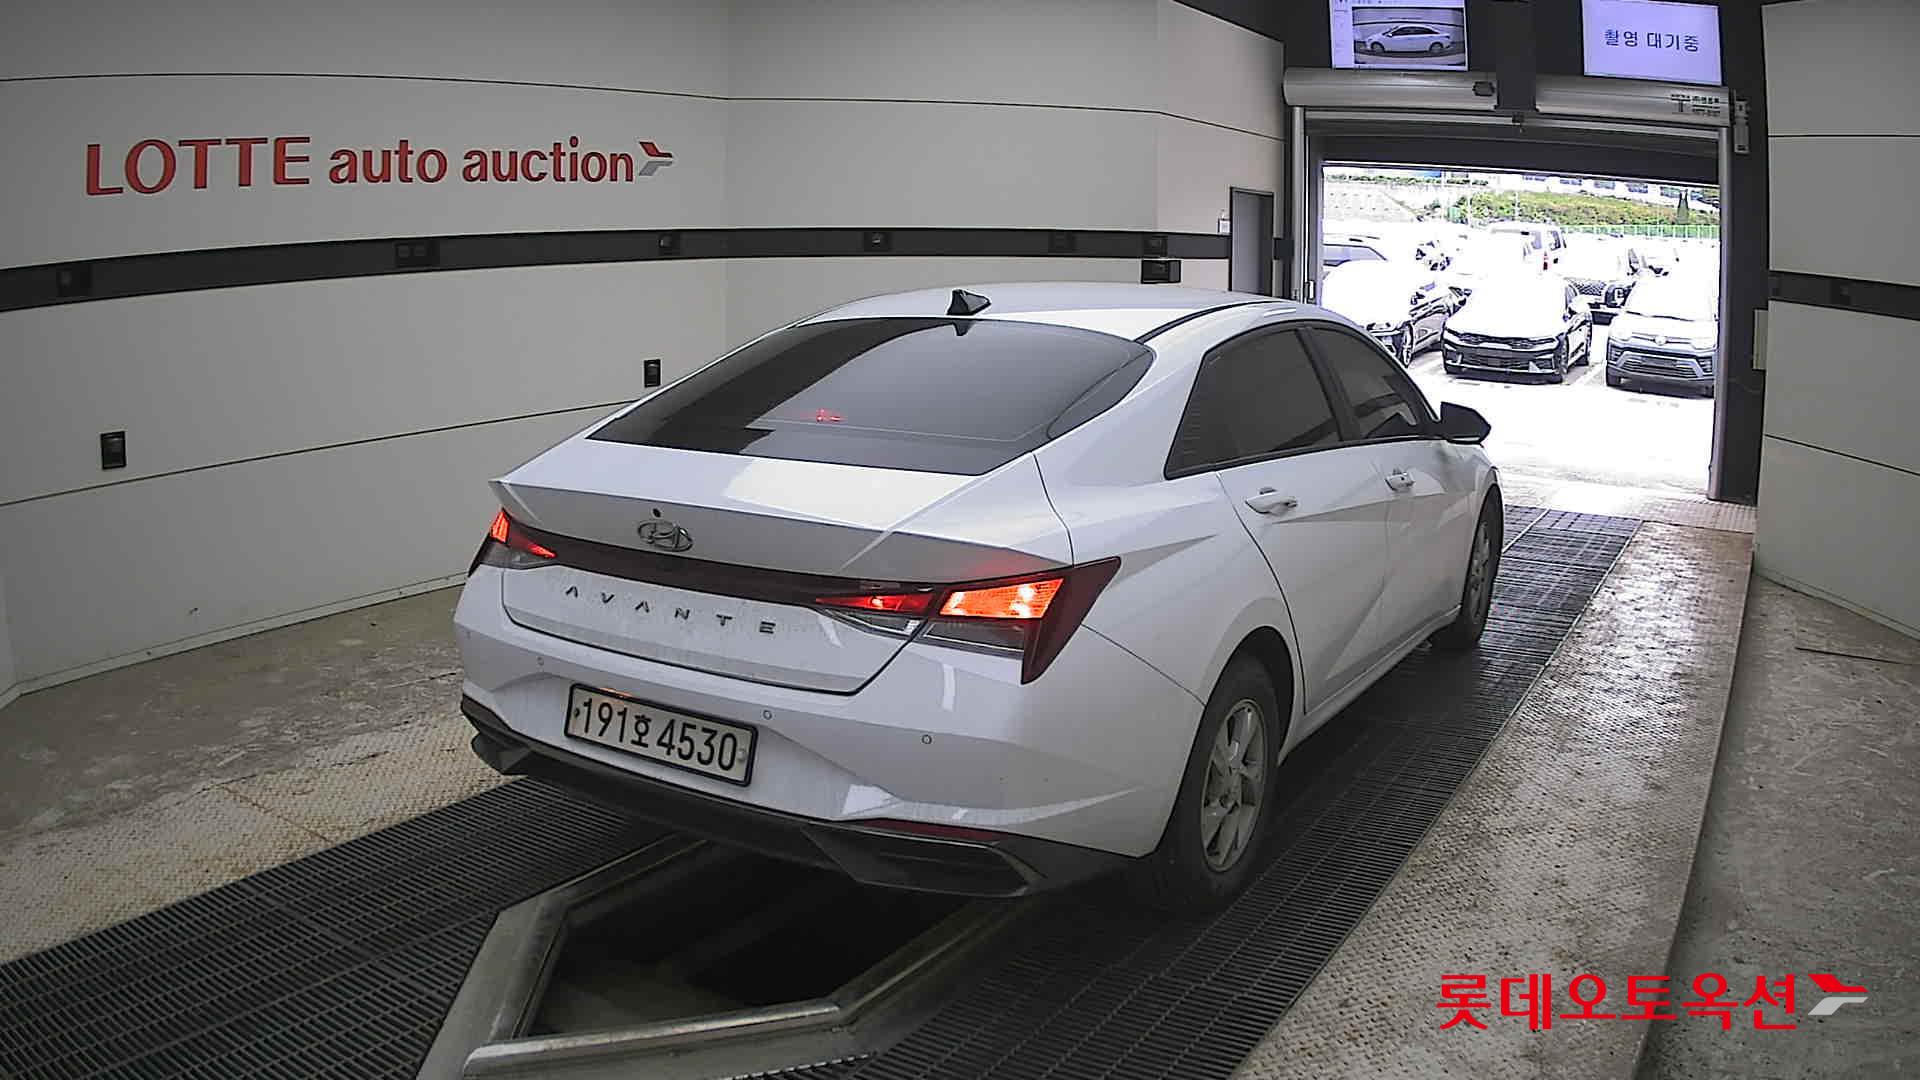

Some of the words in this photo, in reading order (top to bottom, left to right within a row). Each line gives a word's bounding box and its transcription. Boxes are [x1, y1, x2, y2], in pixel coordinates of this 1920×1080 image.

[1604, 29, 1639, 48] 촬영
[1646, 32, 1699, 52] 대기중
[85, 136, 310, 196] LOTTE
[328, 139, 449, 184] auto
[462, 136, 634, 183] auction
[565, 585, 777, 635] AVANTE
